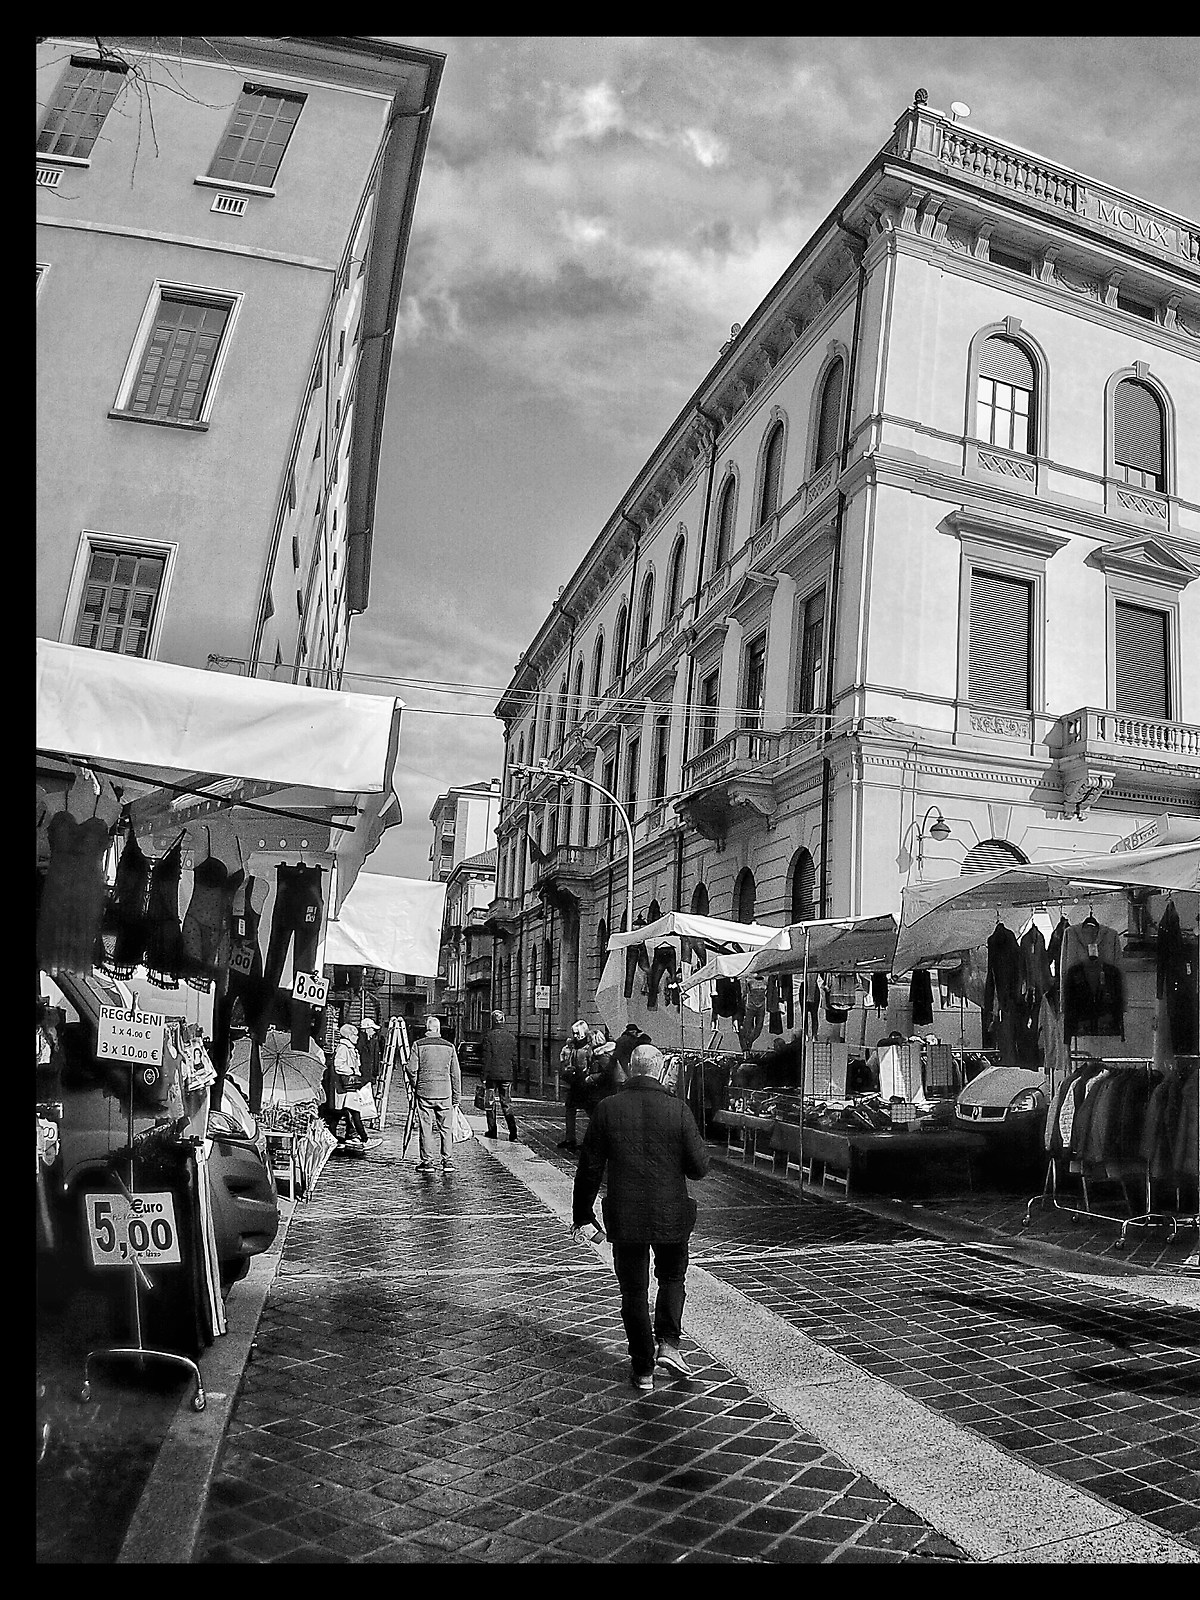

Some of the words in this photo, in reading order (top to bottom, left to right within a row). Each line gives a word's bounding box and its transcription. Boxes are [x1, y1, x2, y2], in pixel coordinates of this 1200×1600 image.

[1097, 199, 1170, 248] MCMX
[296, 975, 325, 1000] 8,00
[101, 1007, 162, 1027] REGGISENI
[111, 1025, 117, 1035] 1
[119, 1028, 124, 1036] x
[126, 1028, 143, 1039] 4.00
[101, 1042, 108, 1053] 3
[111, 1045, 118, 1055] x
[121, 1045, 148, 1059] 10.00
[150, 1049, 159, 1061] €
[94, 1201, 173, 1260] 5,00
